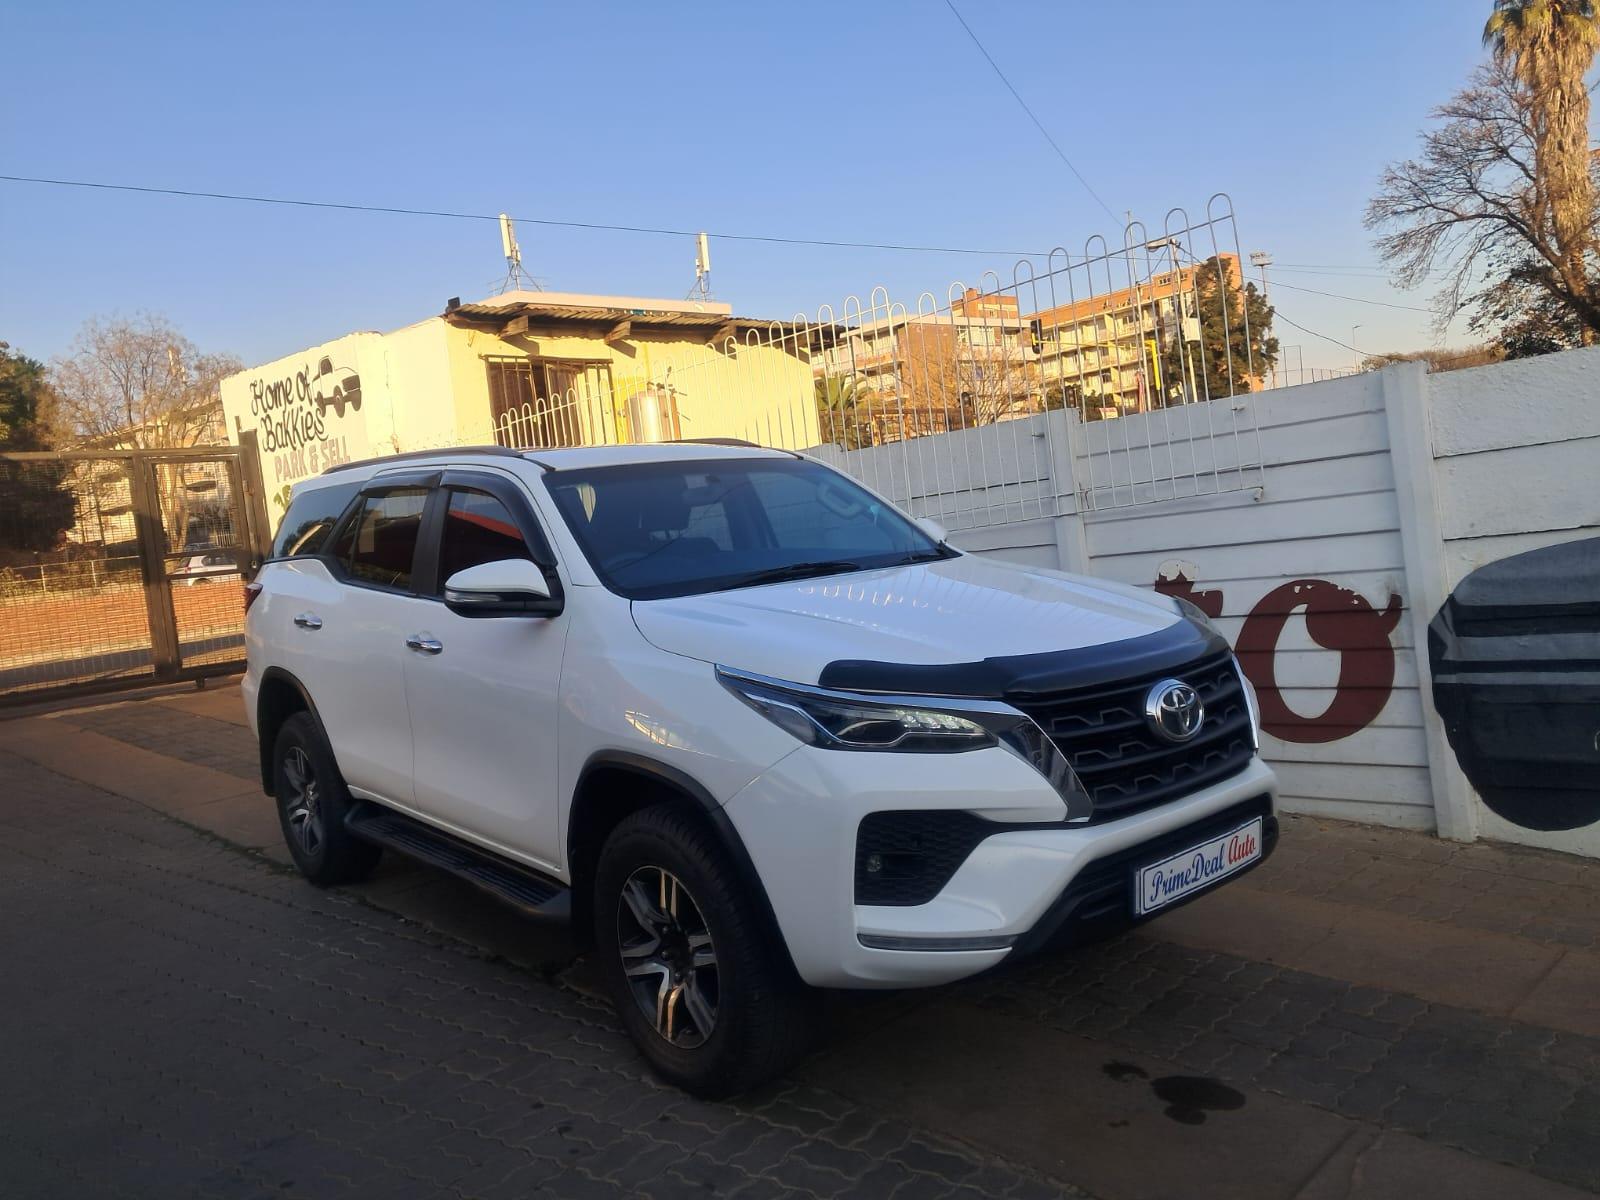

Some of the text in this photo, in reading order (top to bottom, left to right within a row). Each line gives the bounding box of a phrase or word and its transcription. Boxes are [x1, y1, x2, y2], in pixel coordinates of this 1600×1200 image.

[250, 377, 294, 416] Home
[274, 436, 351, 482] PARK & SELL
[1228, 834, 1256, 865] Auto
